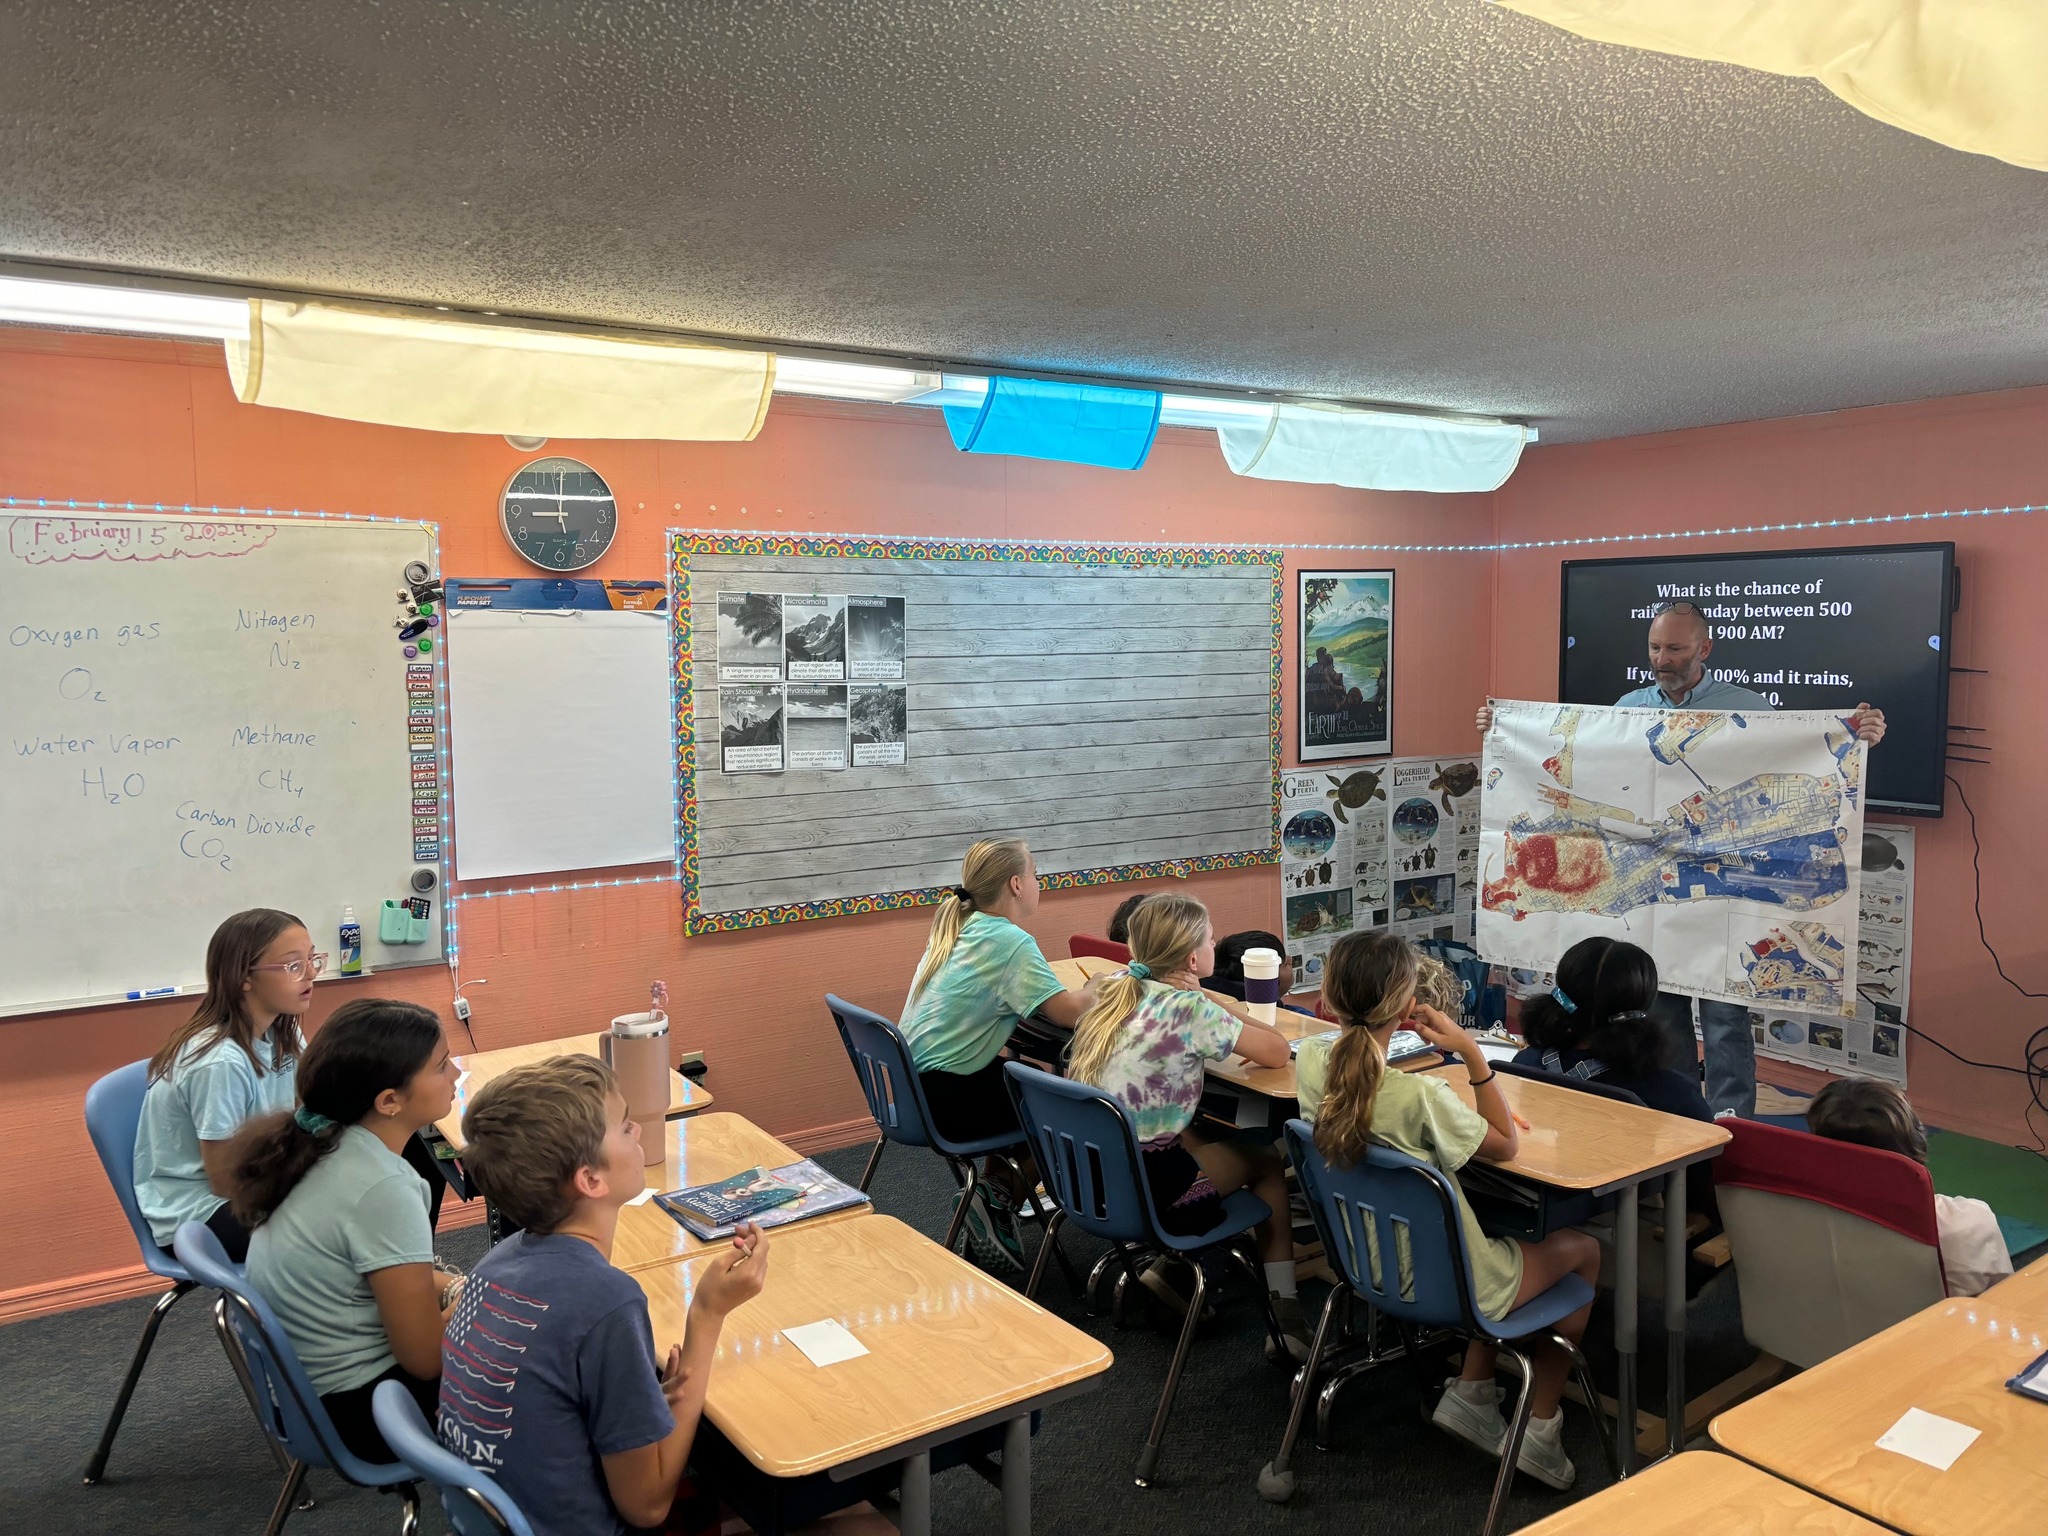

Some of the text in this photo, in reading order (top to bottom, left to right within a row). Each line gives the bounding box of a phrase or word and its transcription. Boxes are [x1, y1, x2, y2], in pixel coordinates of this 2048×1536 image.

[535, 471, 546, 486] 11
[552, 466, 567, 480] 12
[510, 504, 522, 518] 9
[597, 509, 607, 524] 3
[34, 521, 131, 547] February
[181, 523, 247, 541] 2024
[518, 526, 528, 540] 8
[589, 530, 600, 543] 4
[535, 541, 545, 556] 7
[554, 548, 565, 562] 6
[575, 544, 586, 558] 5
[1656, 579, 1823, 598] What is the chance of
[785, 598, 827, 606] Microclimate
[1700, 603, 1740, 621] nday
[1744, 603, 1814, 618] between
[1819, 601, 1852, 616] 500
[10, 622, 160, 647] Oxygen gas
[1717, 625, 1746, 639] 900
[1750, 625, 1784, 639] AM?
[1626, 667, 1638, 680] If
[1707, 669, 1749, 683] 00%
[1753, 670, 1783, 684] and
[1788, 670, 1800, 684] it
[1804, 670, 1853, 688] rains,
[787, 687, 827, 696] Hydrosphere
[850, 687, 883, 695] Geosphere
[232, 723, 316, 747] Methane
[13, 734, 181, 755] Water Vapor
[1393, 767, 1430, 787] LOGGERHEAD
[1283, 777, 1315, 798] GREEN
[176, 800, 316, 837] Carbon Dioxide
